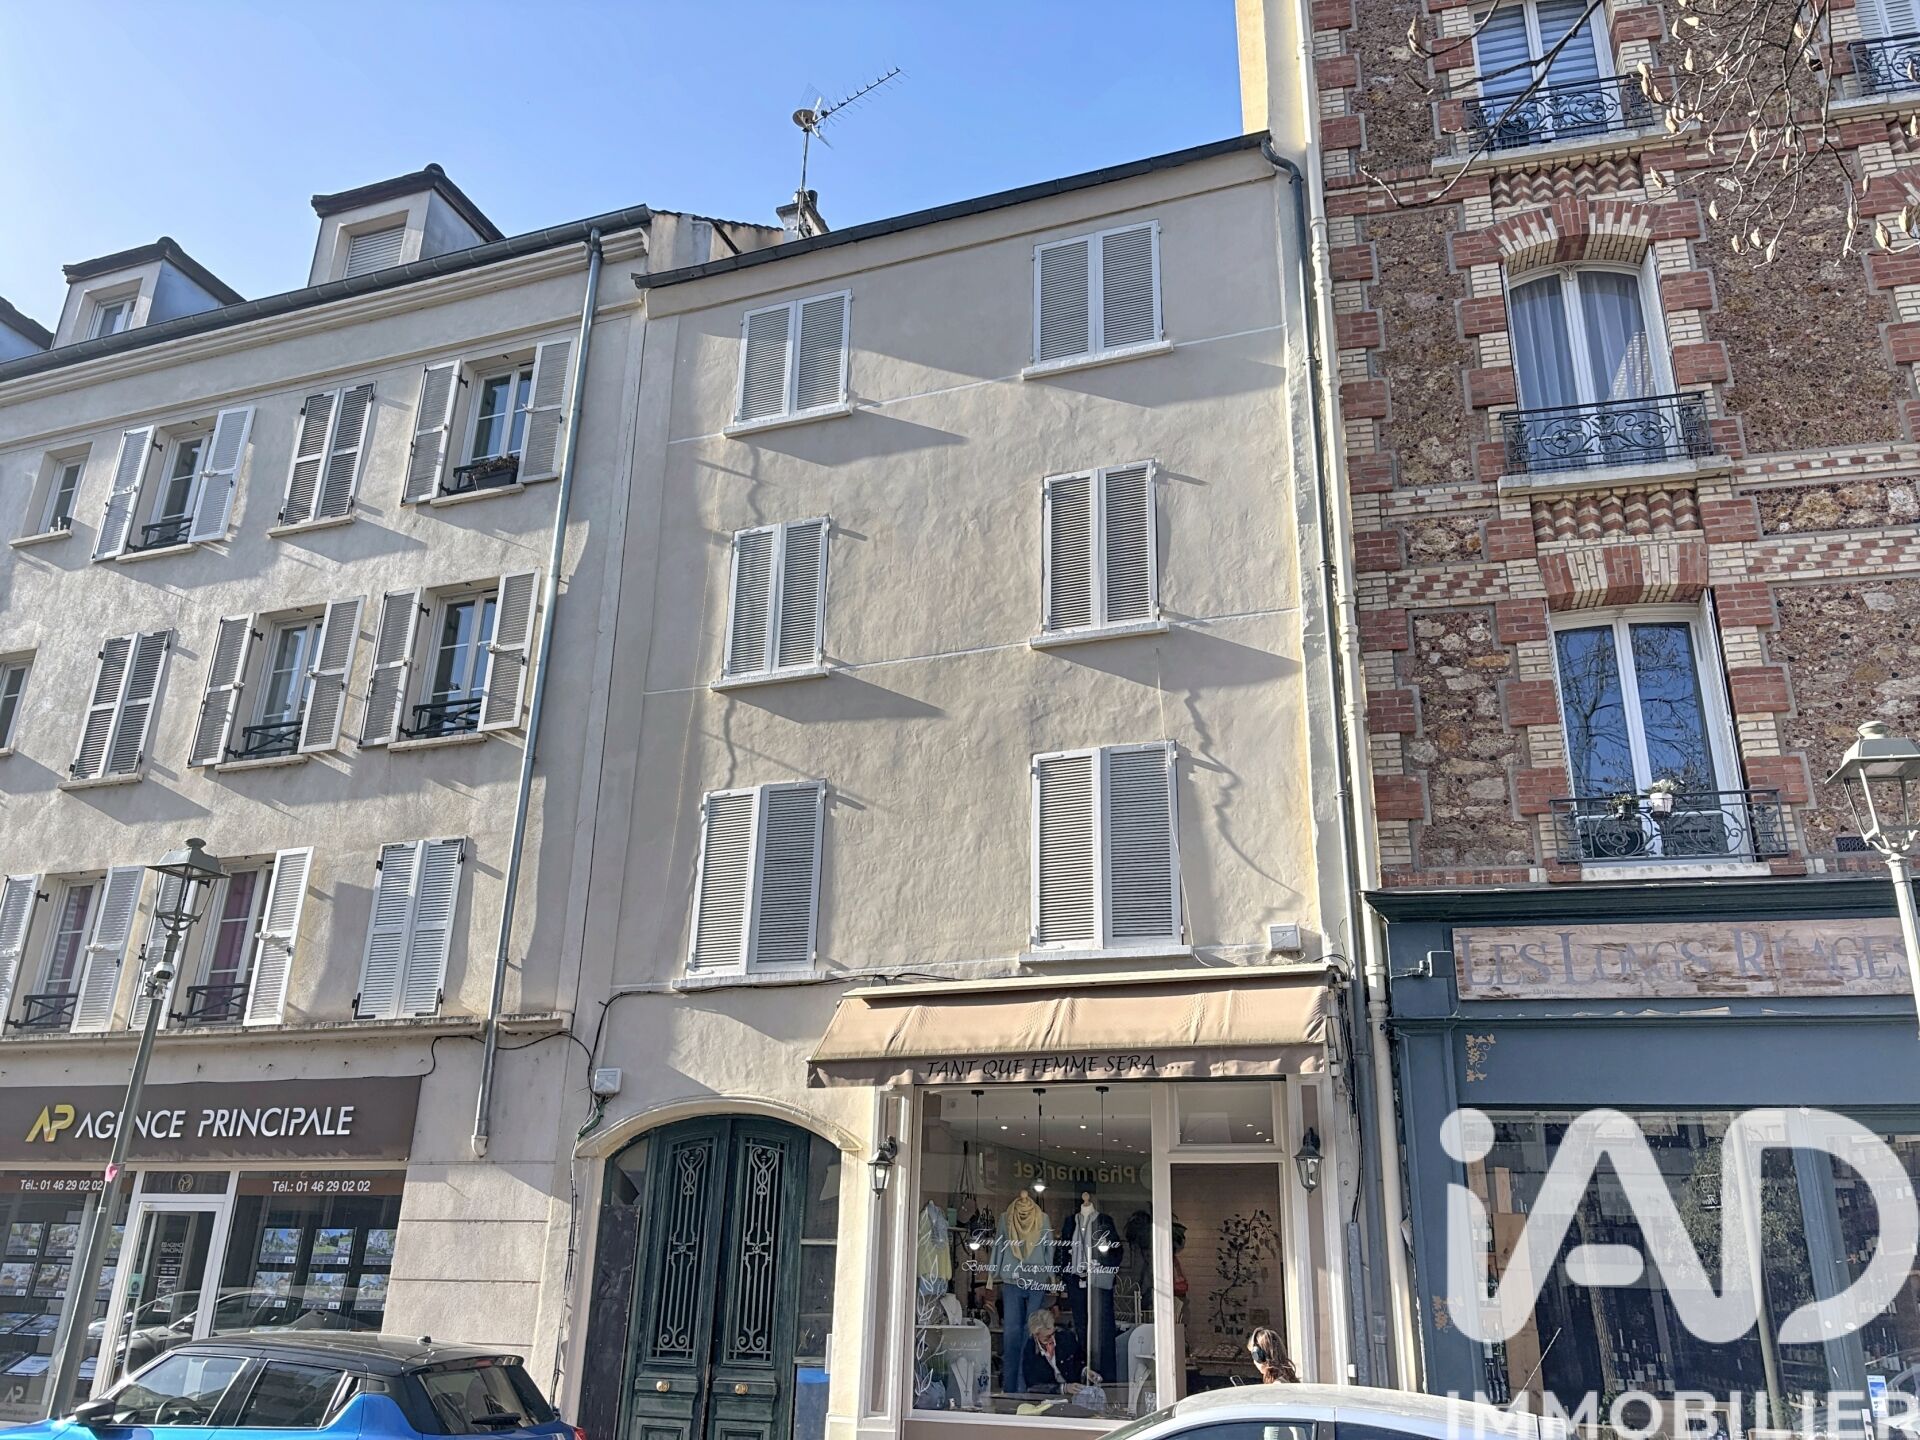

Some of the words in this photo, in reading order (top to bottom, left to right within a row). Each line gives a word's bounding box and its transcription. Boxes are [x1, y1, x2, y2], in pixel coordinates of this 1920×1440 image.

[928, 1060, 979, 1077] TANT
[982, 1058, 1025, 1077] QUE
[1031, 1056, 1100, 1076] FEMME
[1104, 1054, 1157, 1073] SERA
[25, 1104, 75, 1142] AP
[198, 1106, 355, 1137] PRINCIPALE
[40, 1181, 51, 1191] 01
[53, 1181, 64, 1190] 46
[65, 1181, 77, 1190] 29
[79, 1181, 90, 1190] 02
[91, 1181, 104, 1190] 02
[296, 1181, 308, 1192] 01
[311, 1181, 324, 1192] 46
[326, 1181, 340, 1192] 29
[341, 1181, 355, 1191] 02
[357, 1180, 371, 1191] 02
